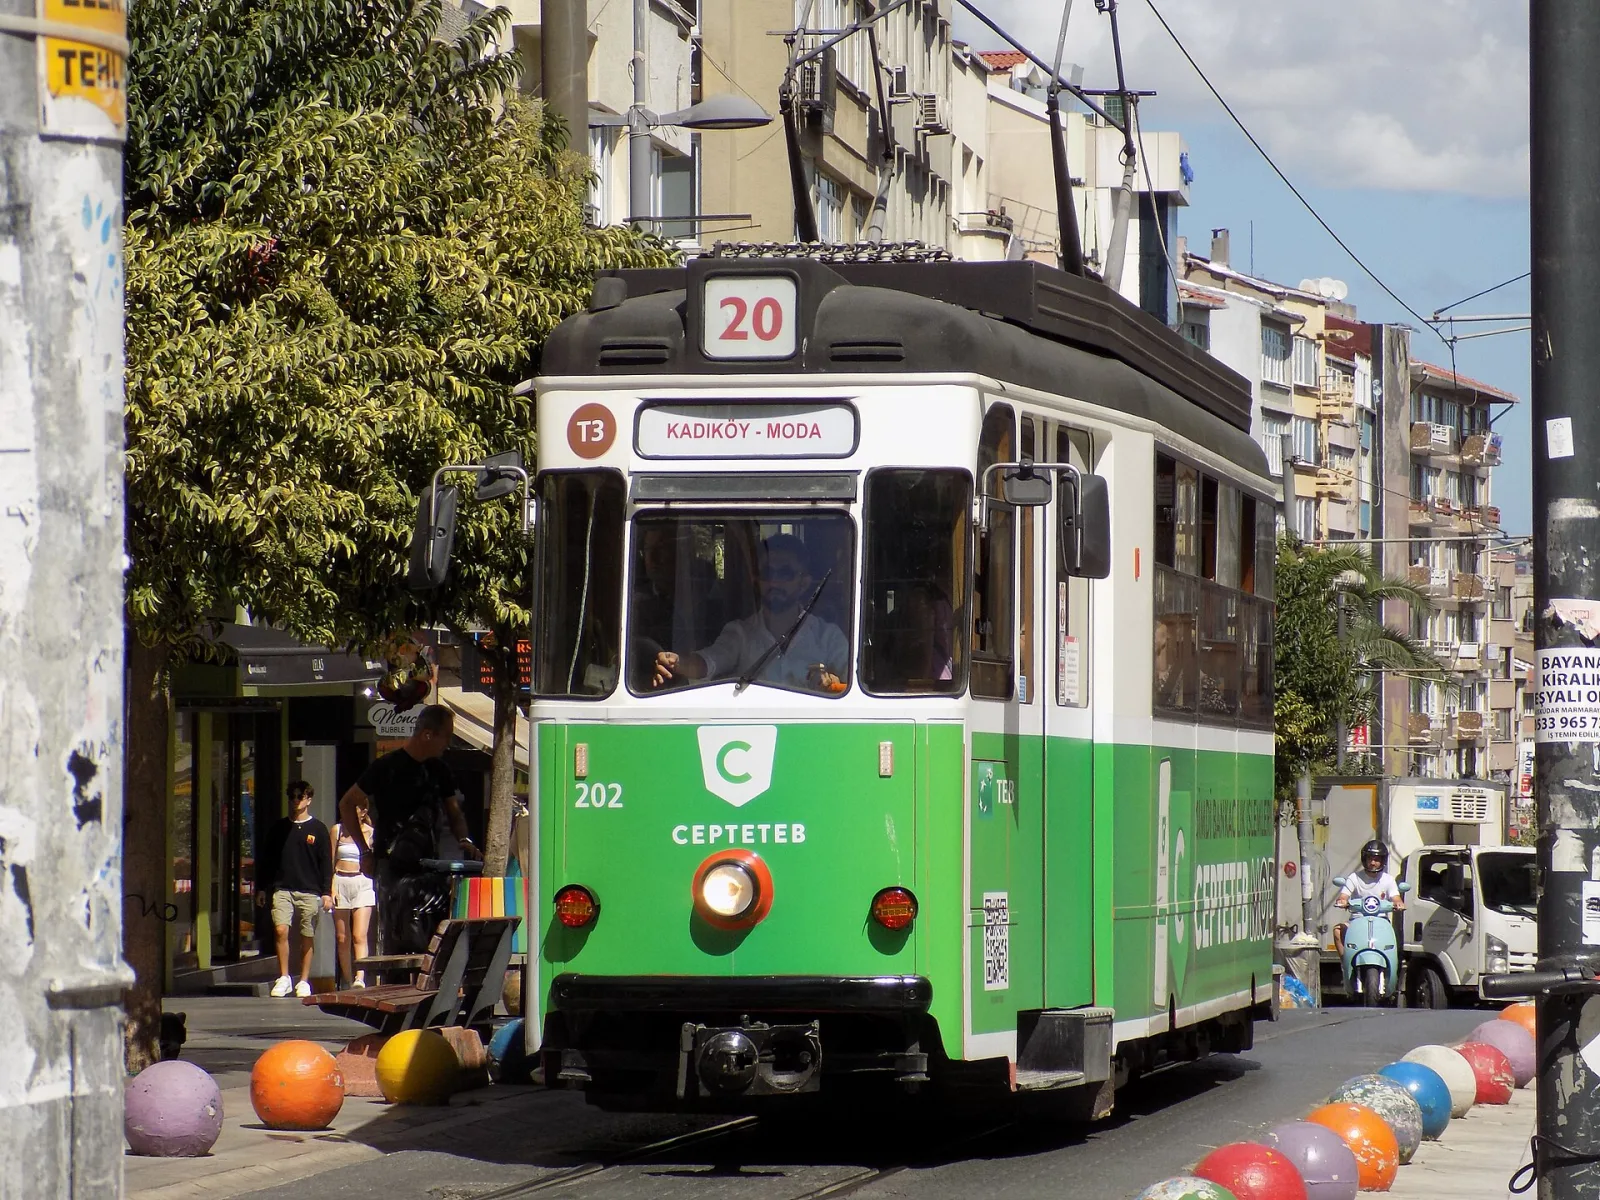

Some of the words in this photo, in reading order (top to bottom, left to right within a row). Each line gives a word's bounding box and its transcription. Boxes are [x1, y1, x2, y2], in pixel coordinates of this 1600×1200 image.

[718, 296, 784, 342] 20
[576, 419, 605, 443] T3
[667, 418, 751, 439] KADIKÖY
[766, 422, 822, 439] MODA
[380, 726, 405, 734] BUBBLE
[1559, 715, 1588, 729] 965
[1554, 730, 1578, 739] TEMİN
[574, 783, 624, 809] 202
[996, 779, 1015, 804] TEB
[672, 823, 807, 845] CEPTETEB
[1194, 861, 1248, 950] CEPTETEB
